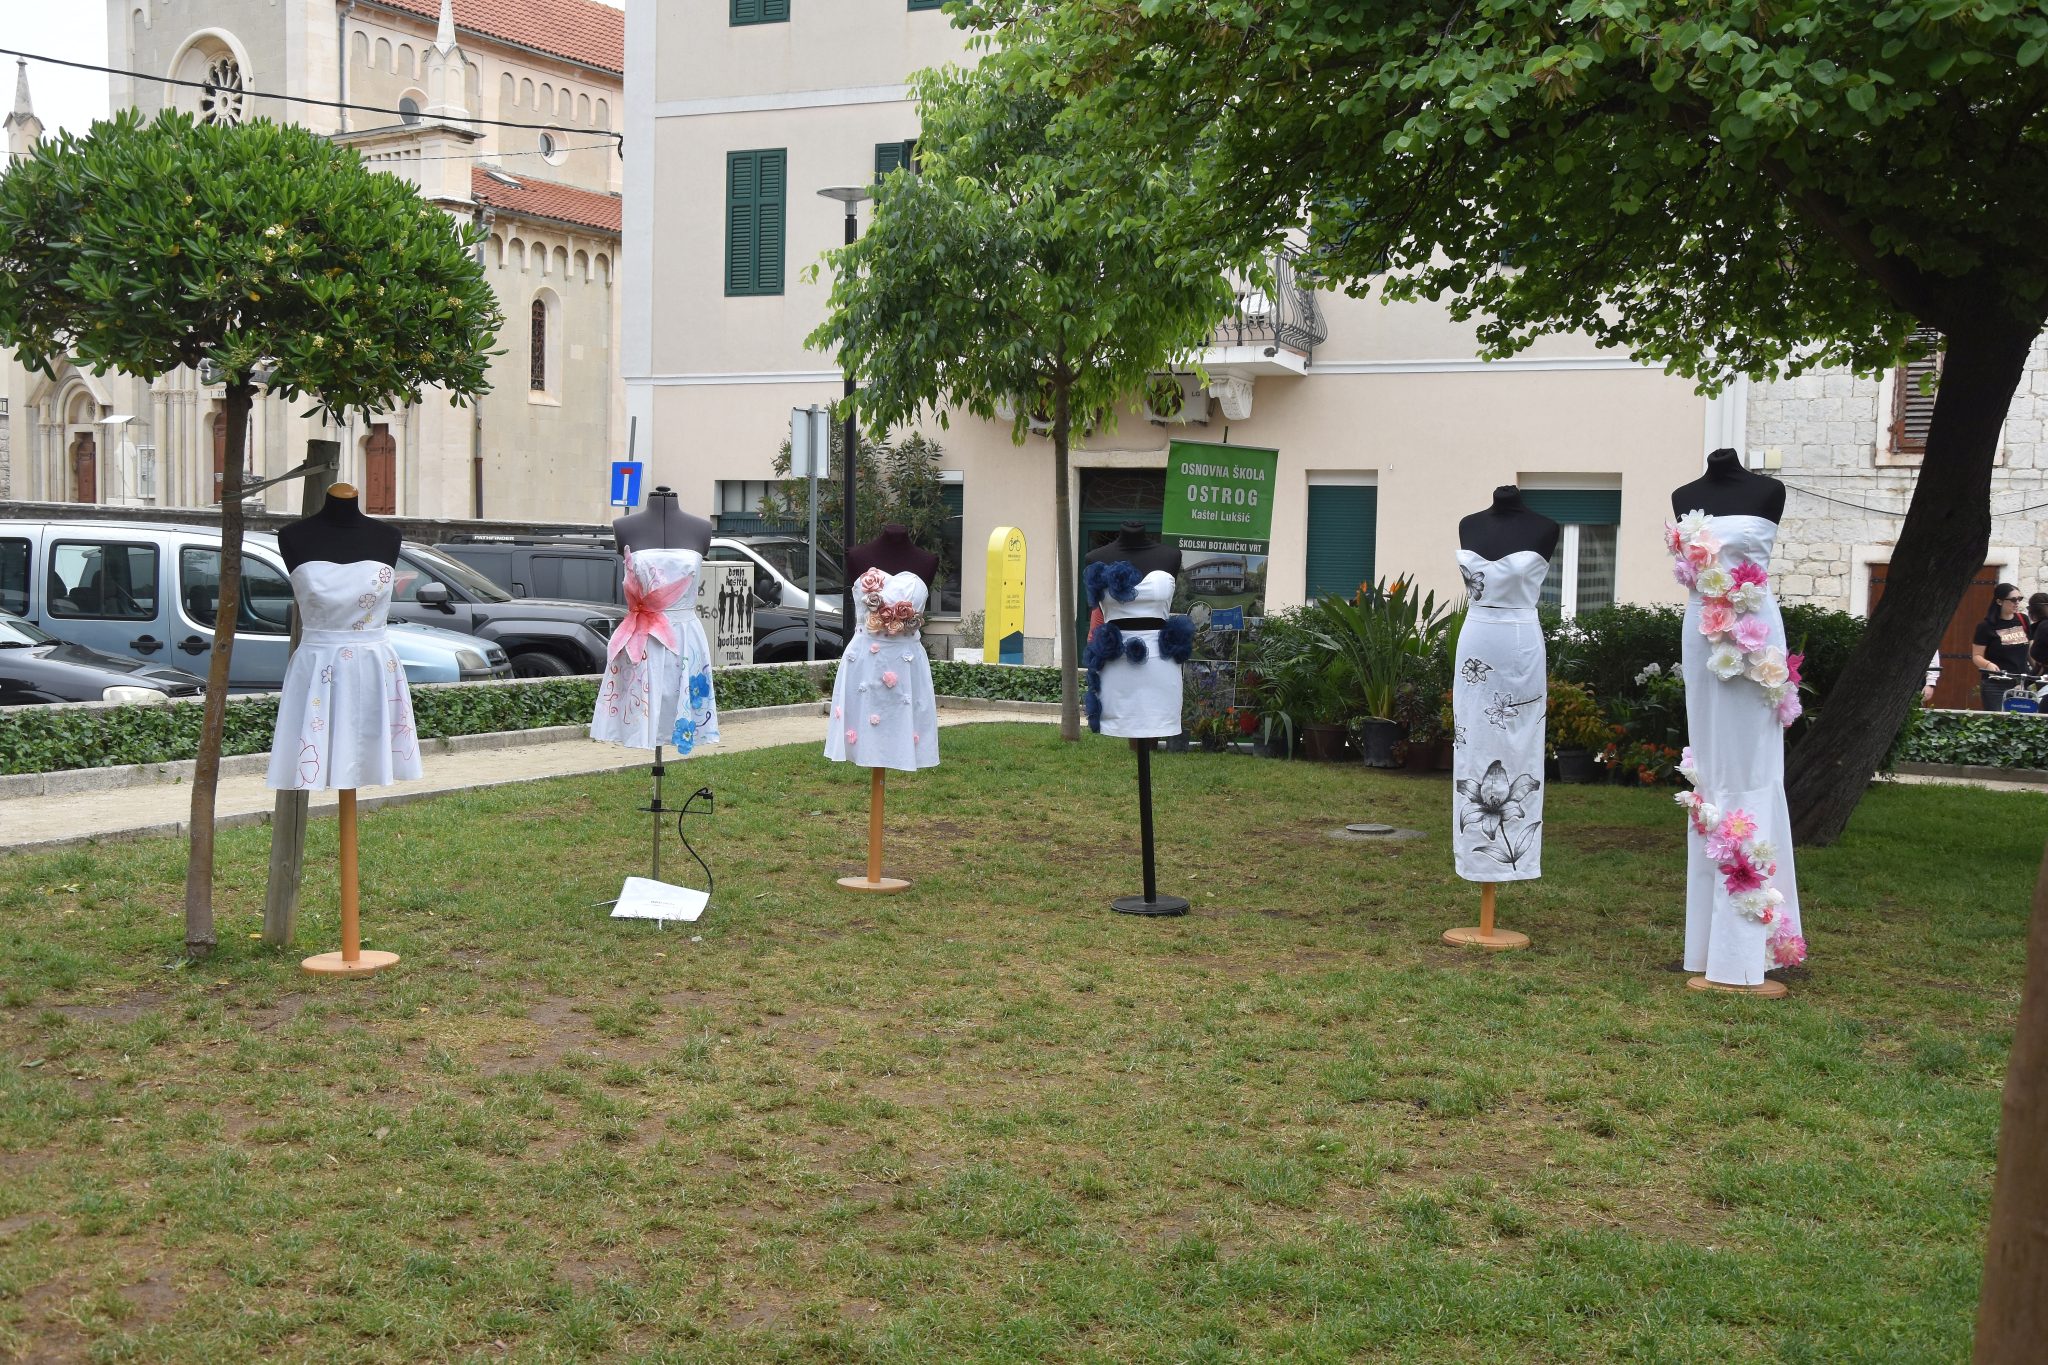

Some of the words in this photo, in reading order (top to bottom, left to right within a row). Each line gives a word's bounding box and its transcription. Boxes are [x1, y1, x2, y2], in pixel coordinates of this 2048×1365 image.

[1181, 463, 1229, 479] OSNOVNA
[1232, 464, 1265, 481] ŠKOLA
[1187, 484, 1258, 506] OSTROG
[1191, 508, 1218, 521] Kaštel
[1220, 510, 1251, 523] Lukšić
[1178, 538, 1207, 550] ŠKOLSKI
[1208, 540, 1247, 552] BOTANIČKI
[1249, 544, 1262, 553] VRT
[717, 634, 752, 649] hooligans
